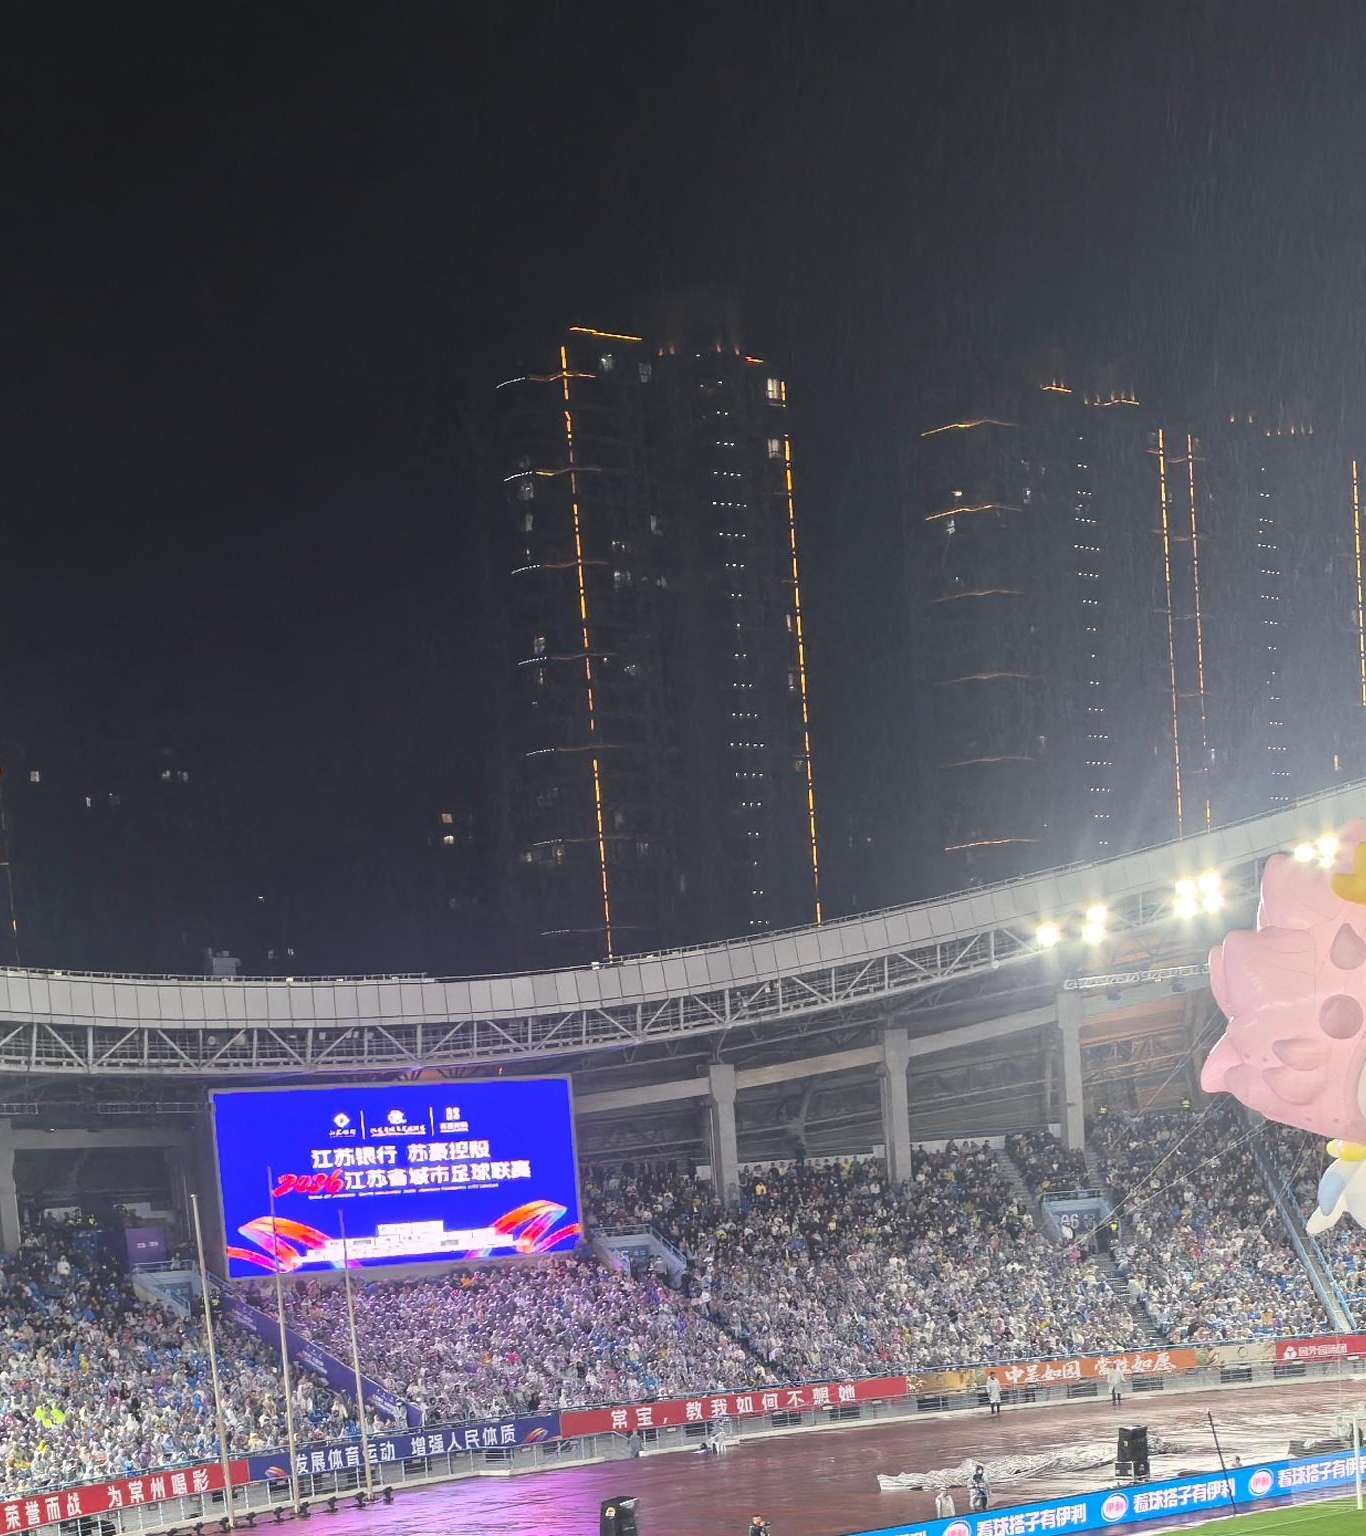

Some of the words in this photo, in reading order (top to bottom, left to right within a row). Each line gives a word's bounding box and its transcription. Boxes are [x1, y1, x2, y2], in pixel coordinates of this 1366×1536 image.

[311, 1145, 398, 1169] 江苏银行
[407, 1140, 491, 1162] 苏豪控股
[344, 1160, 532, 1191] 江苏省城市足球联赛
[611, 1385, 857, 1431] 常宝，教我如何不她
[295, 1440, 396, 1475] 发展体育运动
[410, 1423, 517, 1457] 增强人民体质
[107, 1468, 209, 1508] 为常州喝彩
[1133, 1477, 1236, 1514] 看球搭子有伊利
